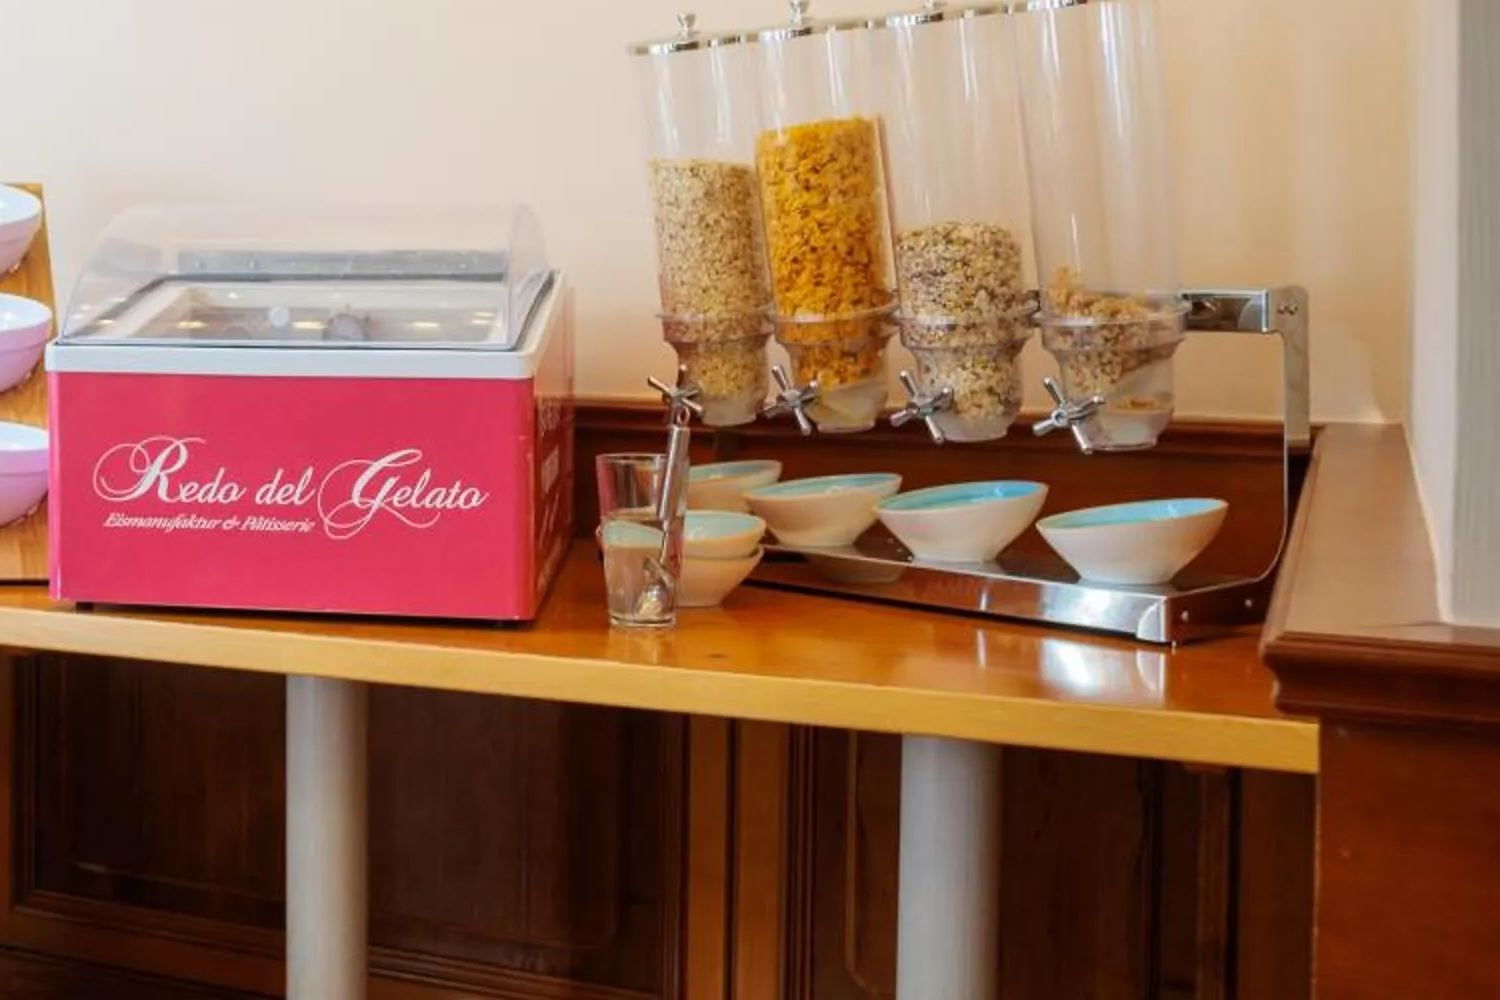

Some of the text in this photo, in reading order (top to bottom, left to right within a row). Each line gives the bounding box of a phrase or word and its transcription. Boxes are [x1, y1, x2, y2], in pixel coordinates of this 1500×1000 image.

[93, 435, 489, 540] Redo del Gelato
[103, 512, 222, 533] Eismanufaktur
[222, 516, 241, 531] &
